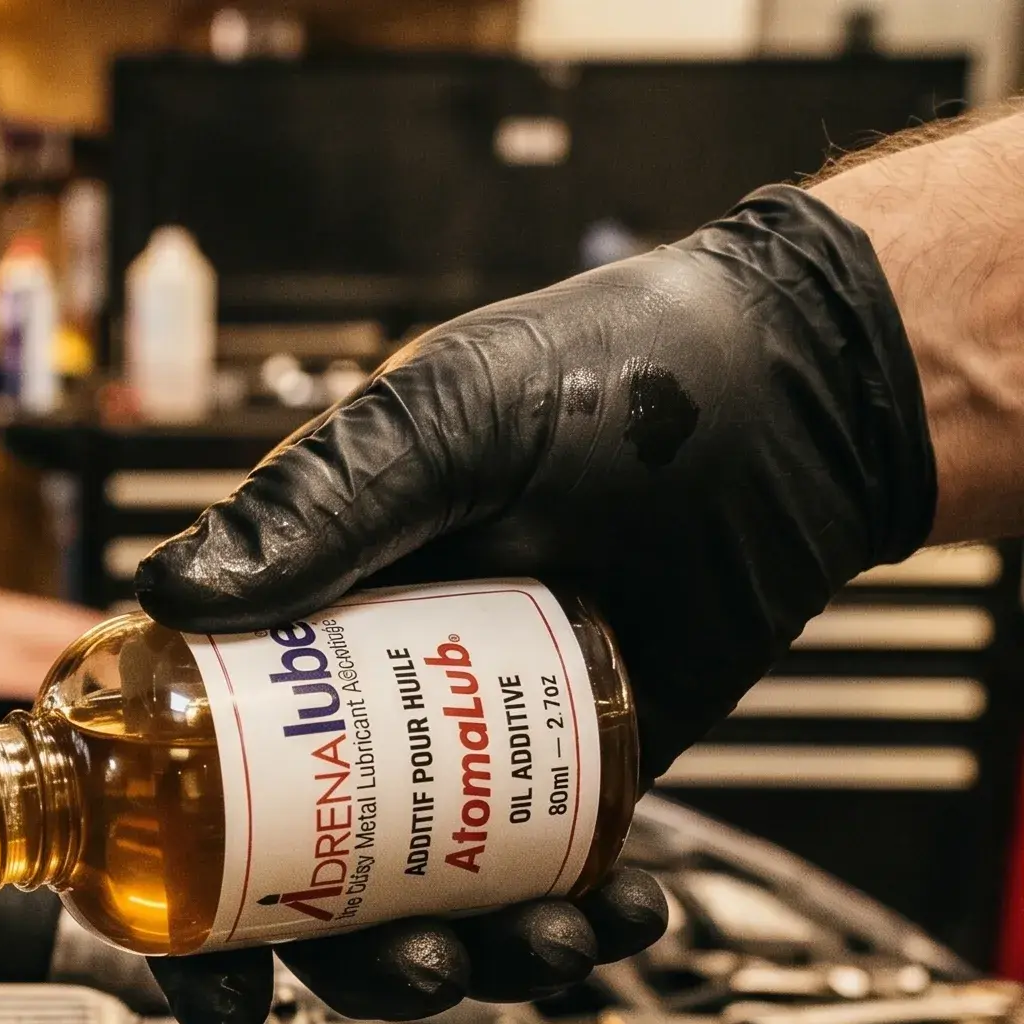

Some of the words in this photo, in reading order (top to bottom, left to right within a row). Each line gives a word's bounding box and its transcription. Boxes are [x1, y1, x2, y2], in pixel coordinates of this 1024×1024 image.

[387, 648, 425, 710] HUILE
[347, 698, 376, 790] Lubricant
[407, 716, 434, 784] POUR
[499, 674, 533, 780] ADDITIVE
[355, 797, 376, 850] Metal
[509, 787, 532, 824] OIL
[548, 766, 569, 816] 80ml
[404, 792, 434, 876] ADDITIF
